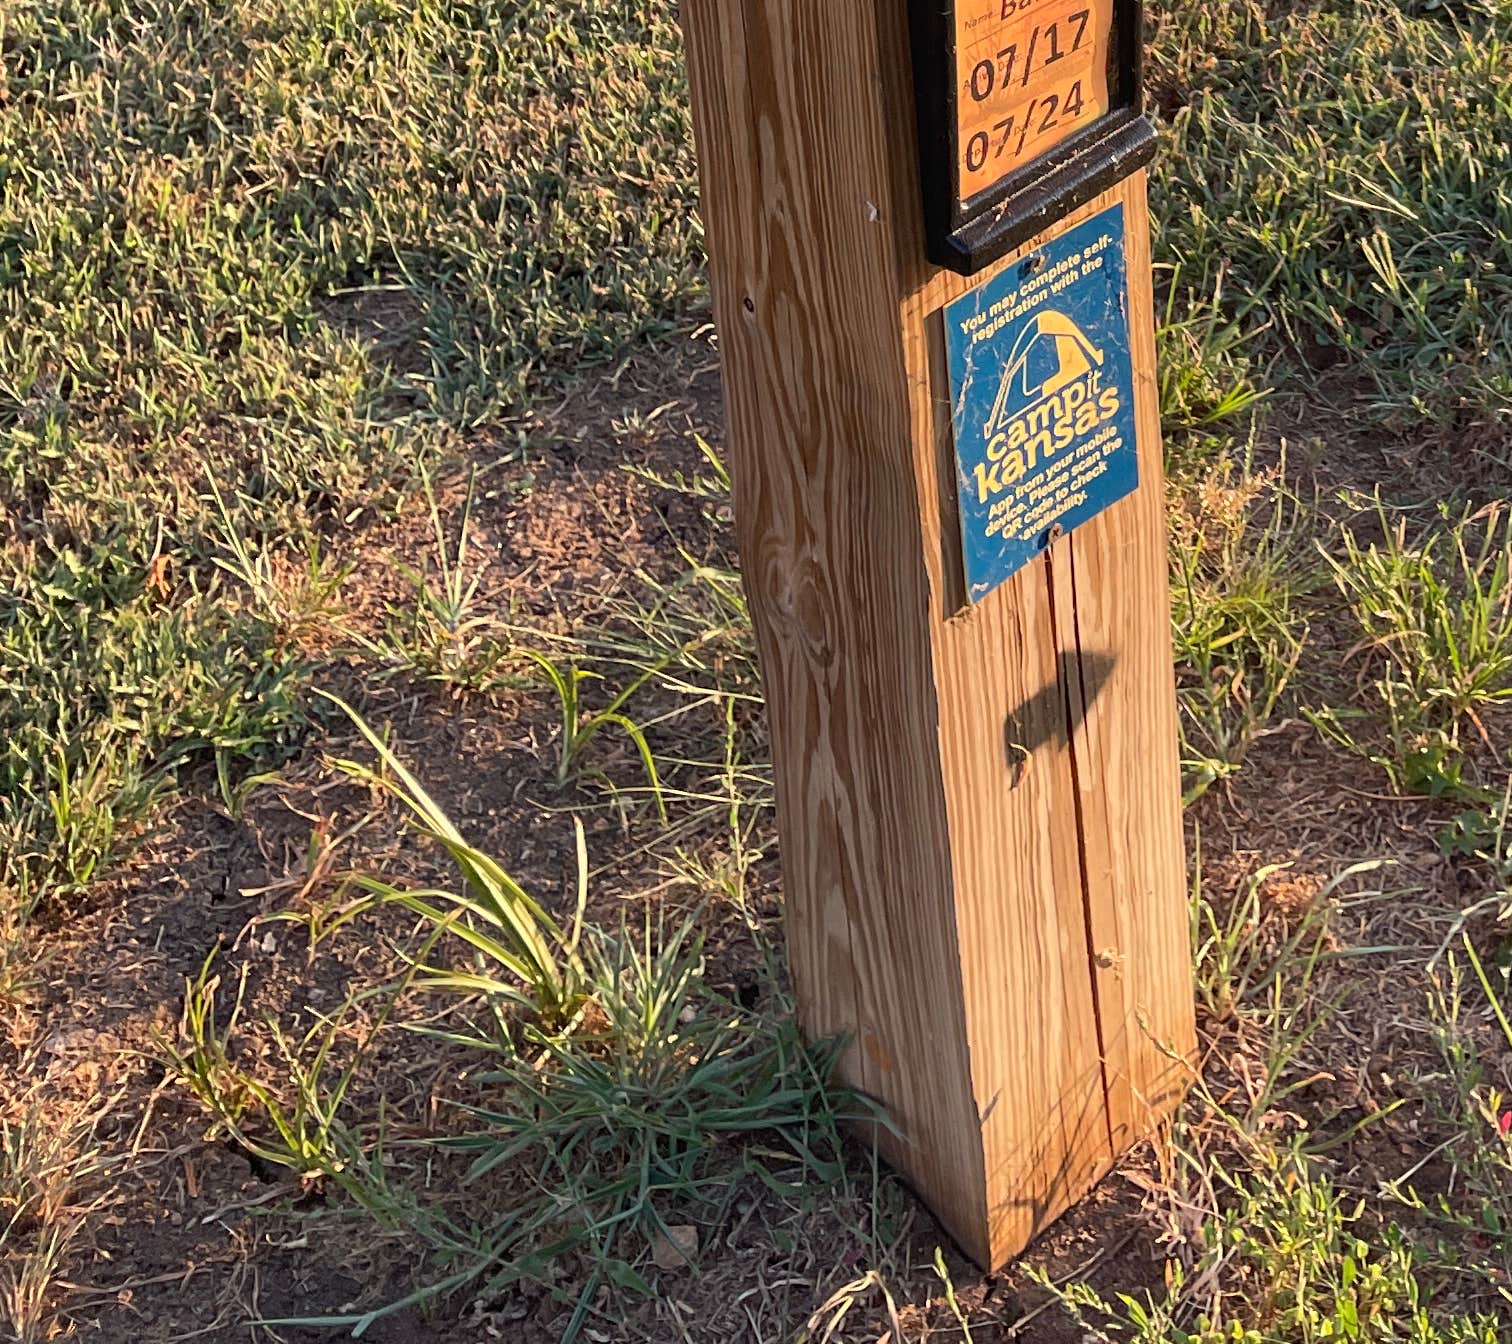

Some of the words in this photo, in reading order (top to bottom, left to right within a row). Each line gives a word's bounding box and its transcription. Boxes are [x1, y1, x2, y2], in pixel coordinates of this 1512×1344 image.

[970, 8, 1090, 102] 07/17
[966, 79, 1085, 172] 07/24
[960, 312, 987, 334] You
[989, 291, 1018, 317] may
[1019, 253, 1082, 297] complete
[1083, 233, 1113, 259] self-
[972, 289, 1049, 345] registration
[1049, 269, 1080, 295] with
[1081, 256, 1104, 276] the
[974, 386, 1121, 504] kansas
[985, 502, 1028, 538] device.
[1029, 471, 1070, 506] Please
[1071, 450, 1101, 476] scan
[1102, 437, 1124, 457] the
[988, 494, 1015, 520] App
[1016, 471, 1045, 499] from
[1046, 453, 1075, 481] your
[1075, 426, 1118, 459] mobile
[1002, 518, 1024, 540] QR
[1024, 497, 1054, 524] code
[1055, 486, 1069, 502] to
[1070, 460, 1109, 492] check
[1023, 489, 1088, 541] availability.
